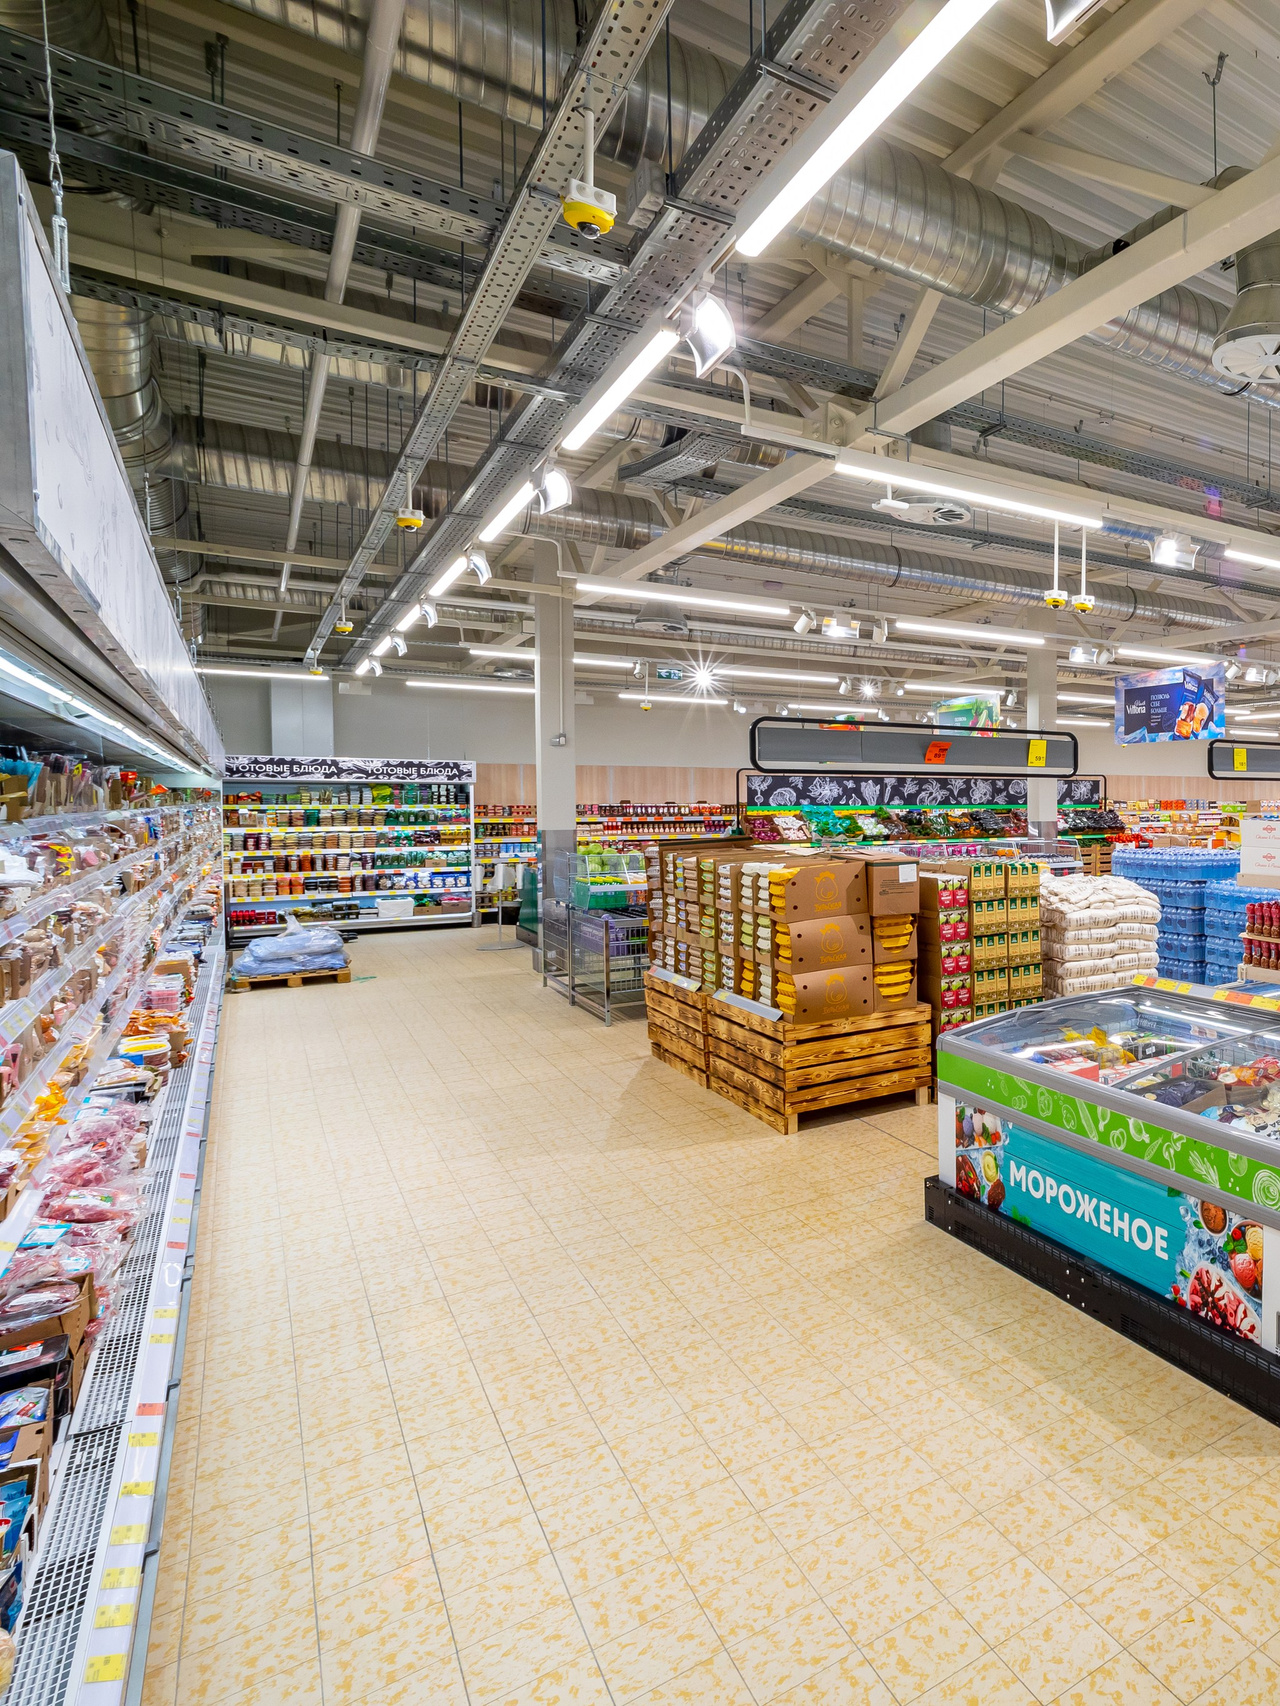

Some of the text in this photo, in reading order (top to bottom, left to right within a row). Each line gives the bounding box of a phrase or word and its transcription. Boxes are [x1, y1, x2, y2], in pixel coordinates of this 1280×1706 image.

[233, 763, 338, 774] ГОТОВЫЕ БЛЮДА
[368, 766, 459, 776] ГОТОВЫЕ БЛЮДА
[1009, 1160, 1170, 1261] МОРОЖЕНОЕ
